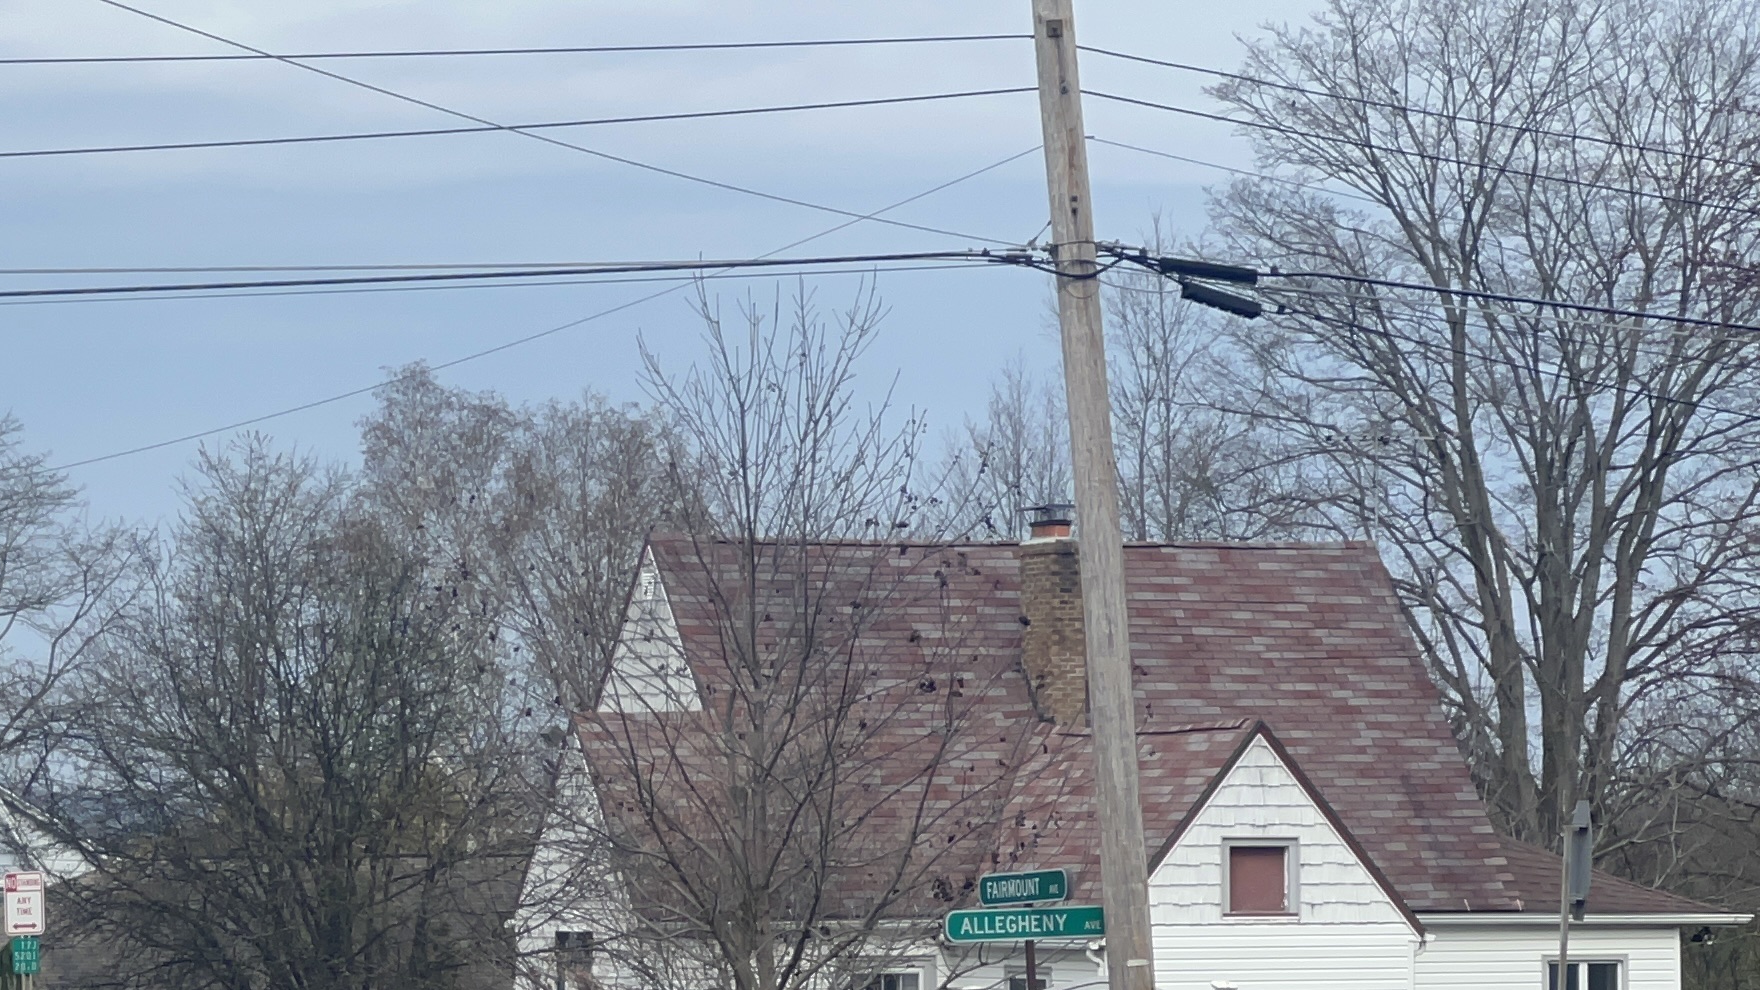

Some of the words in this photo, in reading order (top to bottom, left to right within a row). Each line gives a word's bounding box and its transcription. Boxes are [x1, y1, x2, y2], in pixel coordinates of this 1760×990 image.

[986, 877, 1040, 900] FAIRMOUNT
[17, 896, 32, 905] ANY
[17, 907, 32, 916] TIME
[960, 914, 1068, 935] ALLEGHENY
[1083, 920, 1102, 930] AVE
